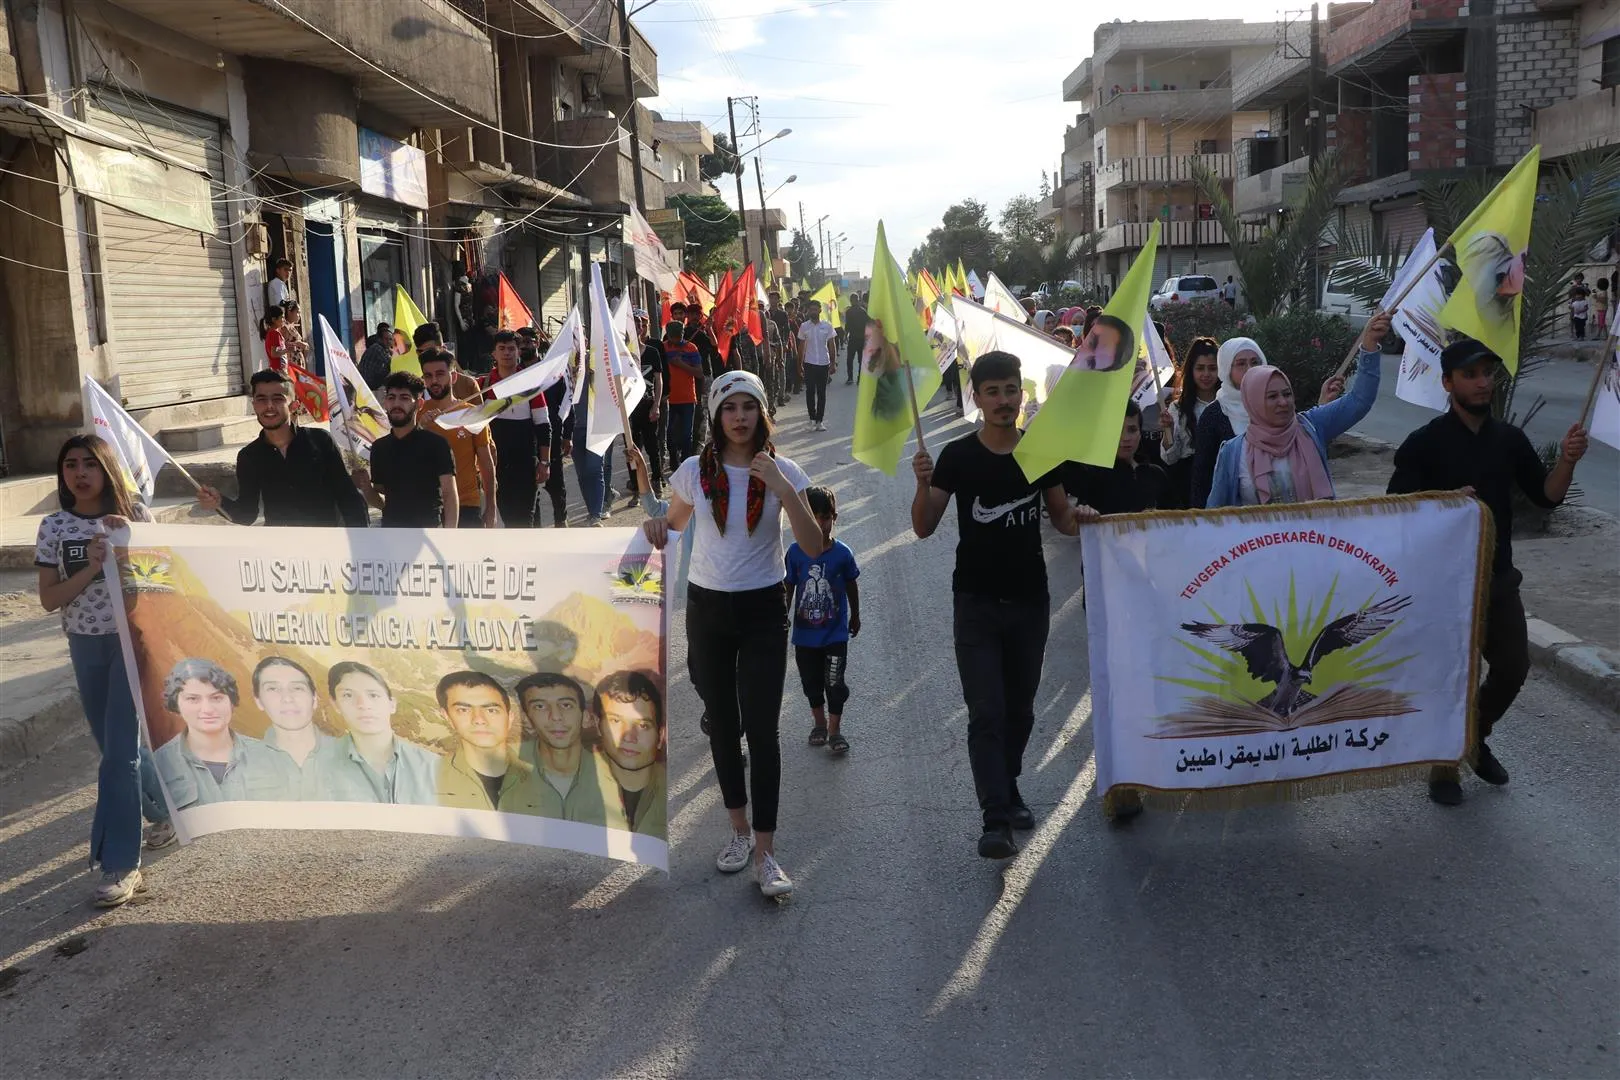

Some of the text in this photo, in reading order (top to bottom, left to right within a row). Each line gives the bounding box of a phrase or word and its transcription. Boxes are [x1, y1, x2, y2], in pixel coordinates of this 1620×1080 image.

[1005, 506, 1038, 528] AIR
[68, 545, 86, 559] 可
[1180, 555, 1231, 600] TEVGERA
[1228, 530, 1325, 560] XWENDEKARÊN
[238, 556, 538, 602] DI SALA SERKEFTINÊ DE
[248, 610, 539, 652] WERIN CENGA AZADIYÊ
[1175, 727, 1391, 773] حركة الطلبة الديمقراطيين
